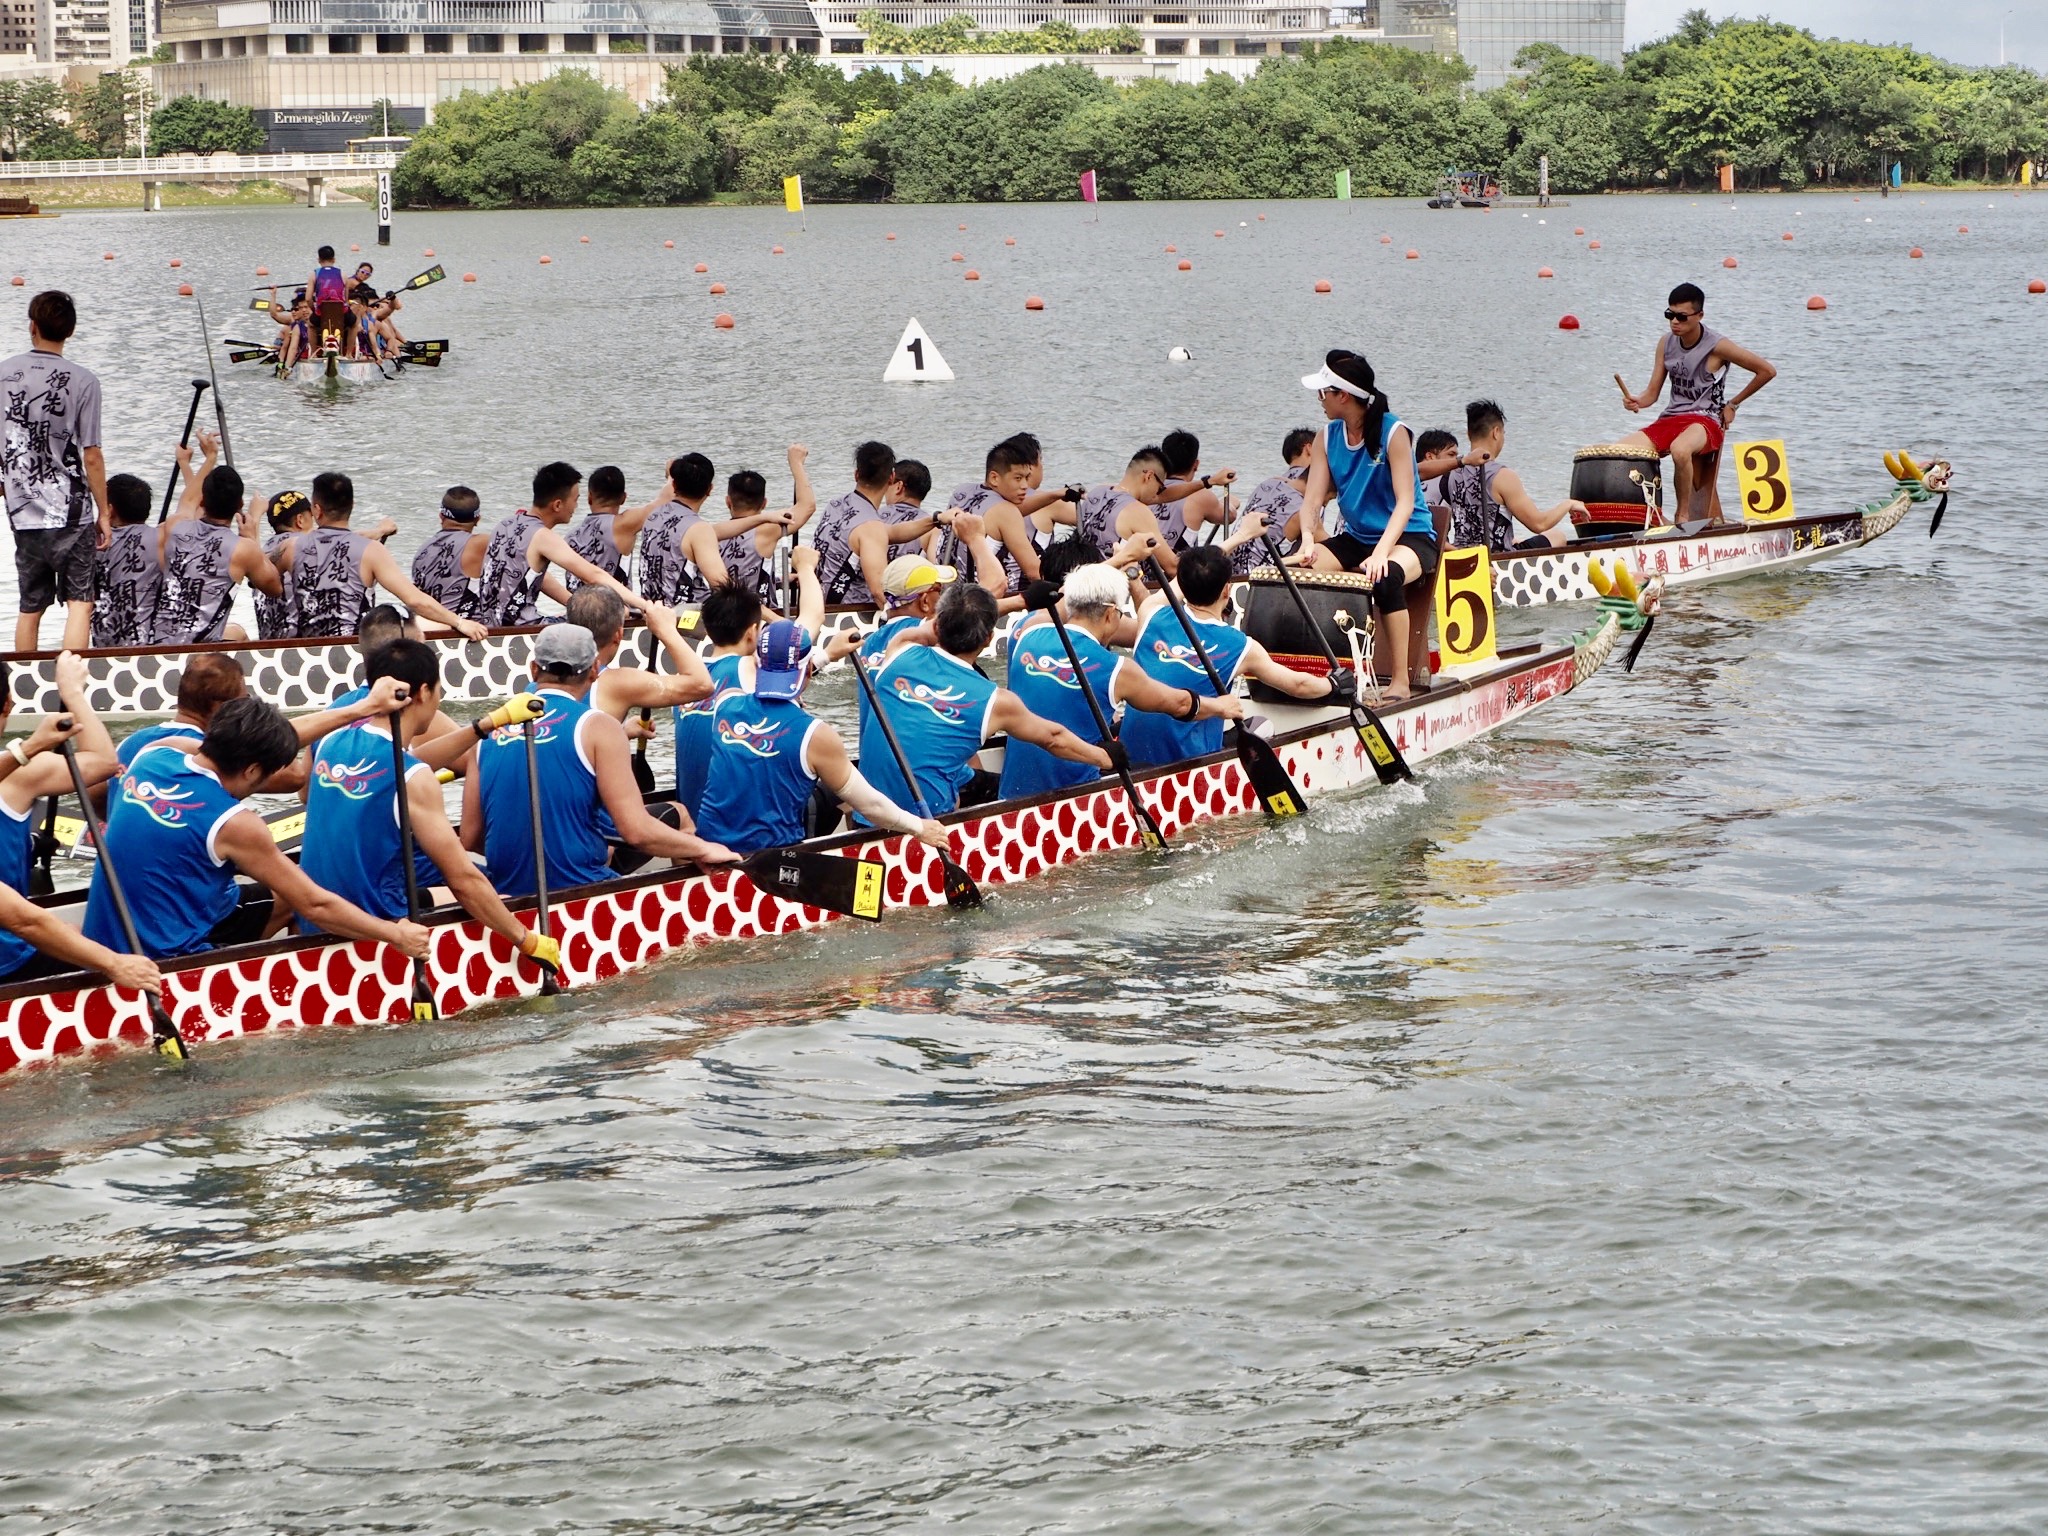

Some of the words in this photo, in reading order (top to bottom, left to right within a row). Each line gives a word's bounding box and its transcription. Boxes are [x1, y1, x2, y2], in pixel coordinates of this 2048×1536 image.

[274, 111, 340, 126] Ermenegildo
[380, 176, 389, 221] 100
[907, 338, 924, 371] 1
[1743, 445, 1787, 514] 3
[1752, 541, 1785, 555] CHINA
[1444, 553, 1489, 654] 5
[761, 631, 770, 653] WILD
